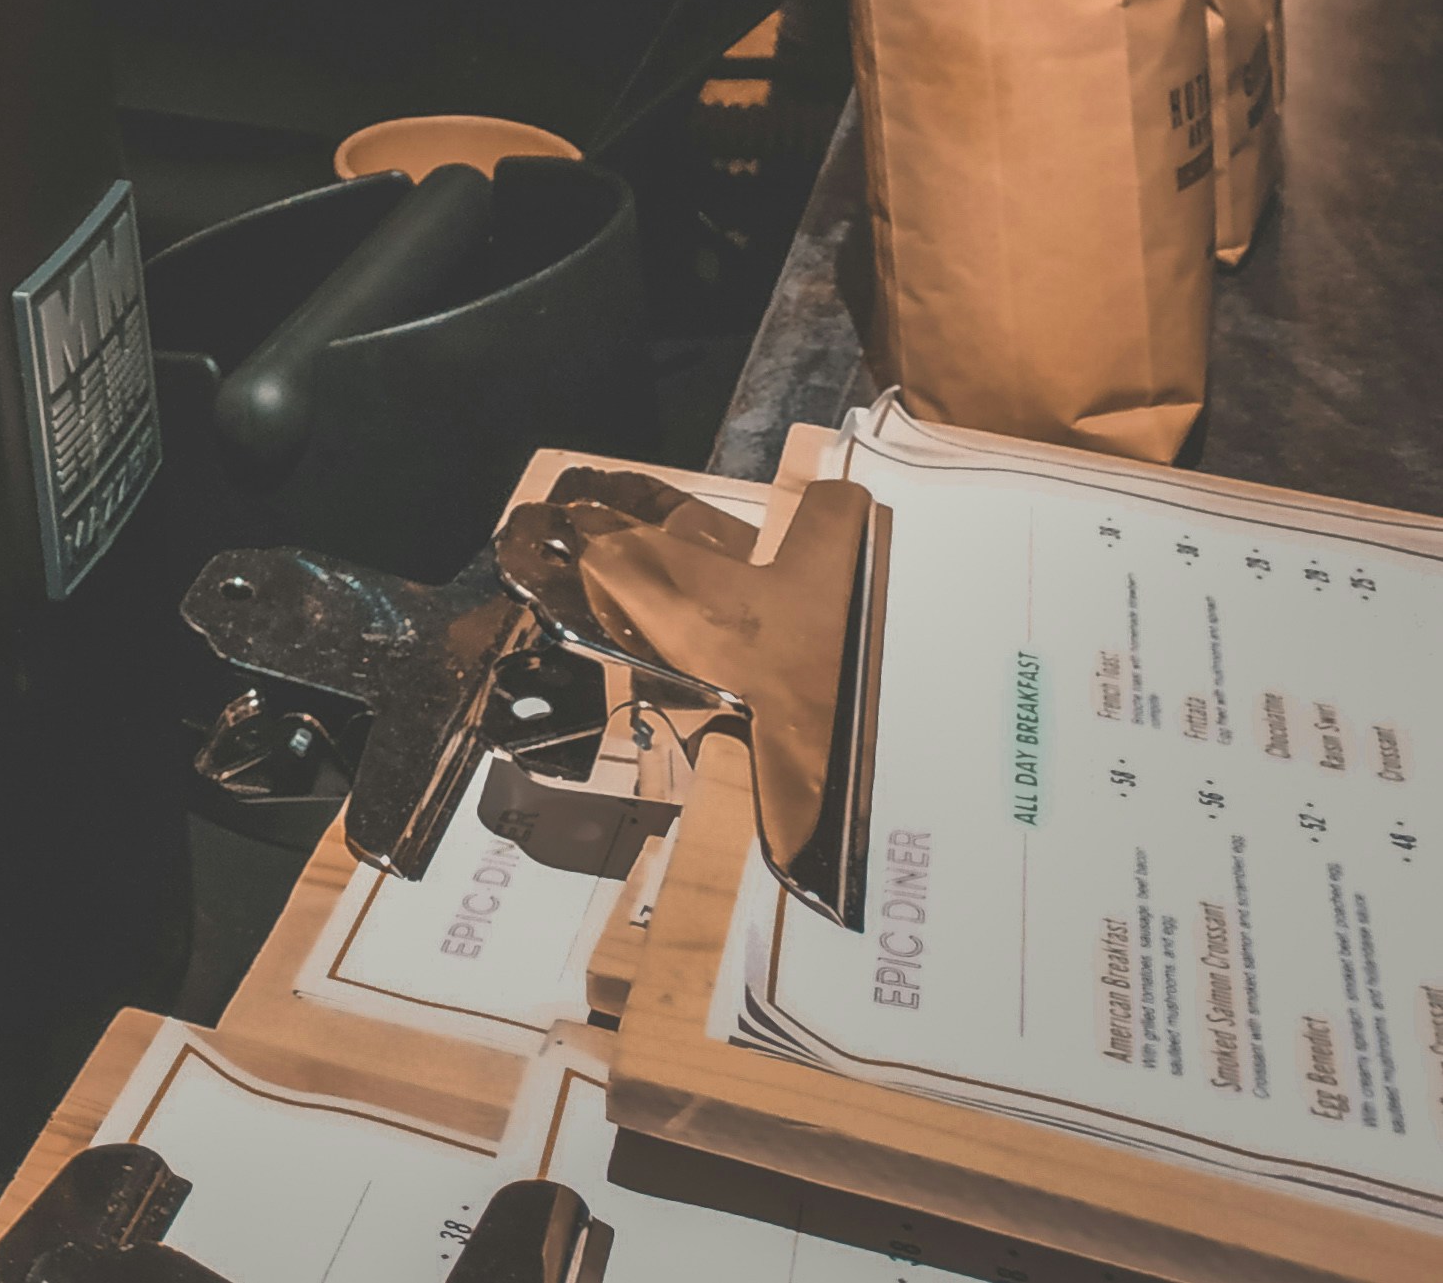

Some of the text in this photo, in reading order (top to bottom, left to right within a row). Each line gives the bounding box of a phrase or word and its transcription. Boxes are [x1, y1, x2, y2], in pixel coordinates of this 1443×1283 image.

[1096, 651, 1121, 721] French Toast
[1182, 696, 1208, 741] Frittata
[1013, 651, 1040, 826] ALL DAY BREAKFAST
[1263, 693, 1291, 759] Chocolatine
[1313, 702, 1345, 770] Raisin Swirl
[1373, 726, 1405, 781] Croissant
[1110, 770, 1136, 787] 58
[1198, 790, 1224, 808] 56
[1299, 813, 1327, 832] 52
[1389, 833, 1416, 850] 48
[440, 809, 539, 958] EPIC DINER
[874, 829, 931, 1010] EPIC DINER
[1101, 918, 1133, 1063] American Breakfast
[1199, 901, 1242, 1092] Smoked Salmon Croissant
[1250, 1043, 1269, 1099] Croissant
[1302, 1016, 1350, 1120] Egg Benedict
[440, 1220, 472, 1244] 38
